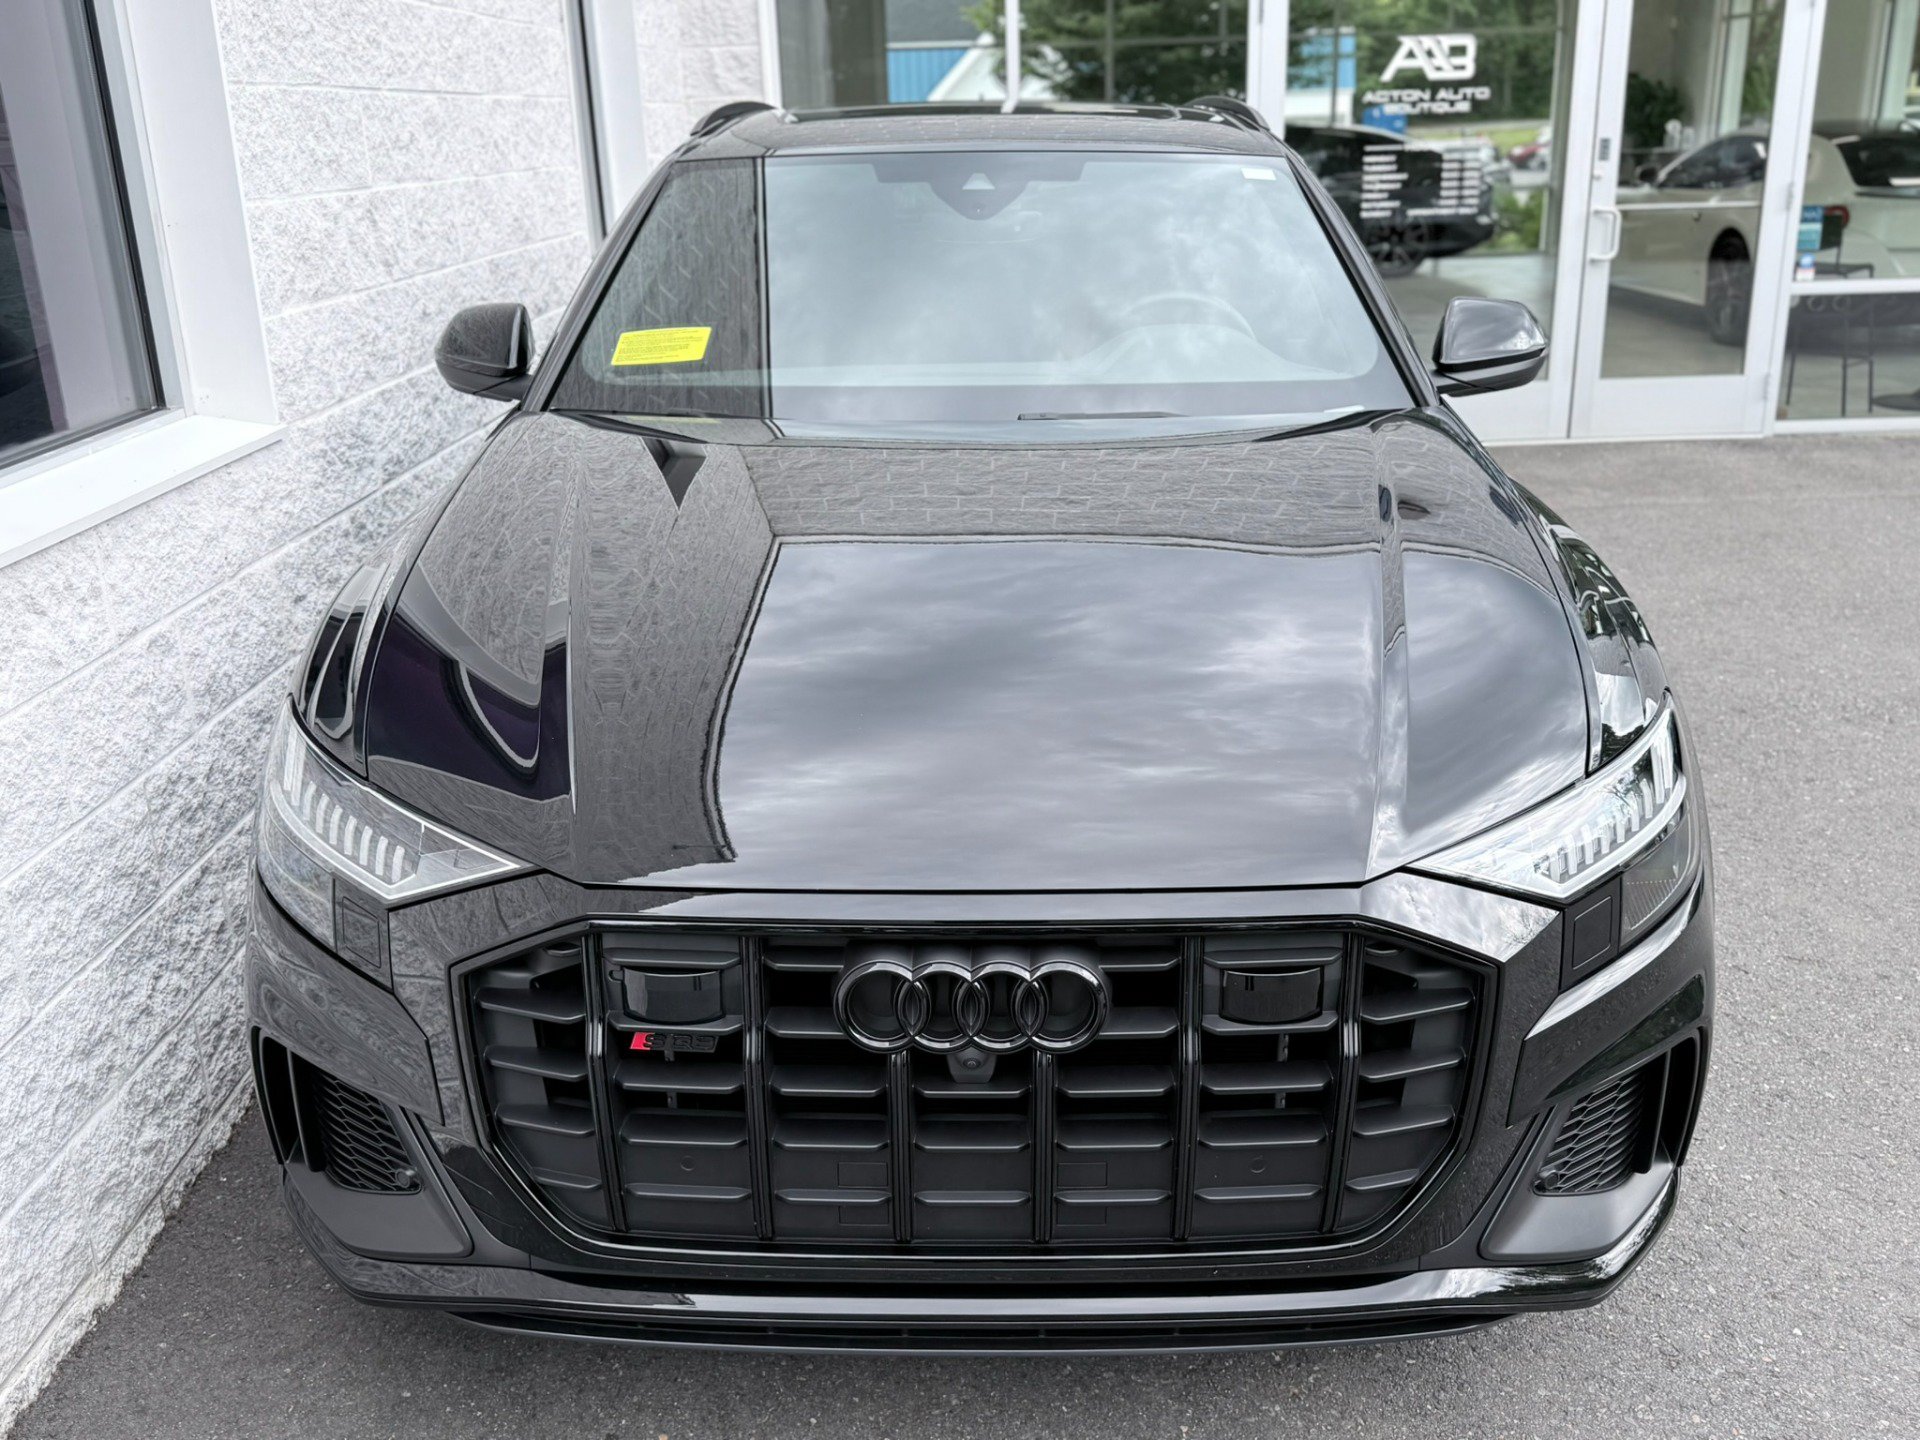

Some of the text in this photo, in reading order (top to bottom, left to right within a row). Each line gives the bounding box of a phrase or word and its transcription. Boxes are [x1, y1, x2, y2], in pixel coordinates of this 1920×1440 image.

[1362, 86, 1491, 104] ACTON AUTO
[1383, 101, 1471, 115] BOUTIQUE
